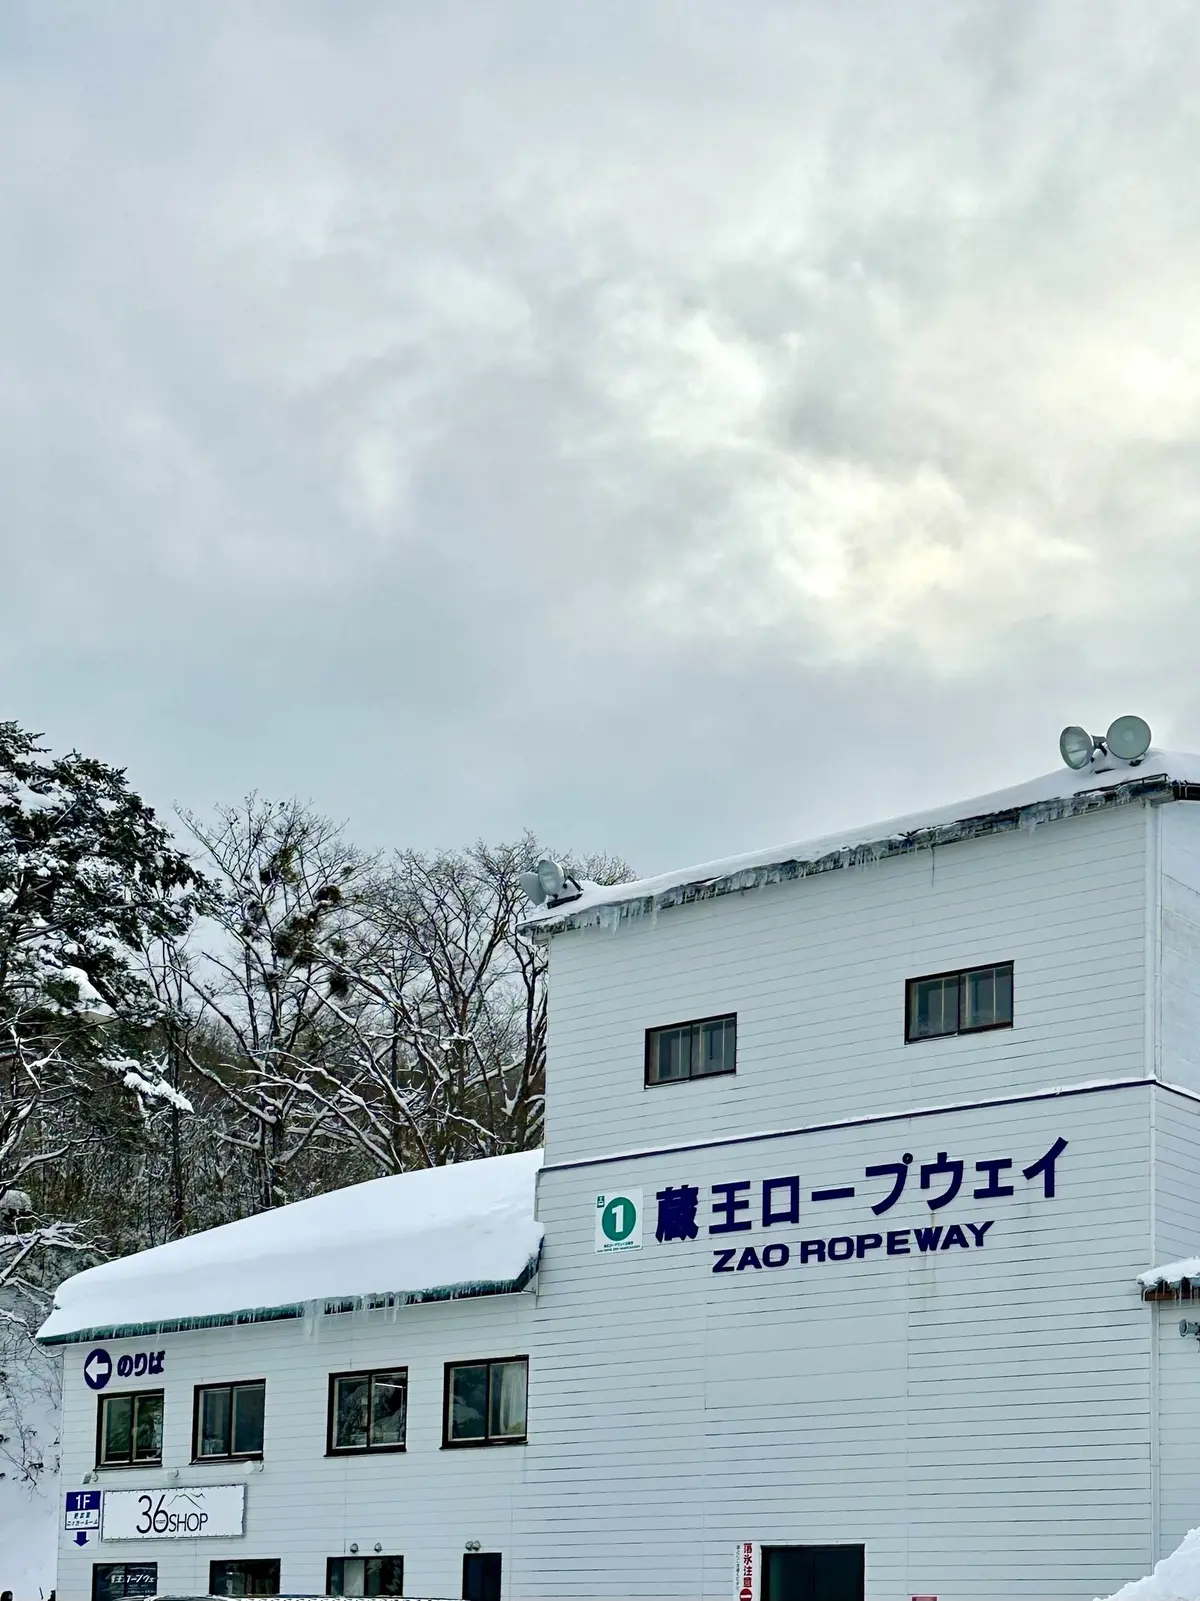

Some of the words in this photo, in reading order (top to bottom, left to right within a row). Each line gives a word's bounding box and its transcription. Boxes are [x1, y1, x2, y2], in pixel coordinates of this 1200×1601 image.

[655, 1136, 1069, 1243] 蔵王ロープウェイ
[611, 1204, 624, 1233] 1
[712, 1243, 790, 1273] ZAO
[799, 1220, 995, 1264] ROPEWAY
[117, 1350, 166, 1377] のりば
[75, 1494, 91, 1509] 1F
